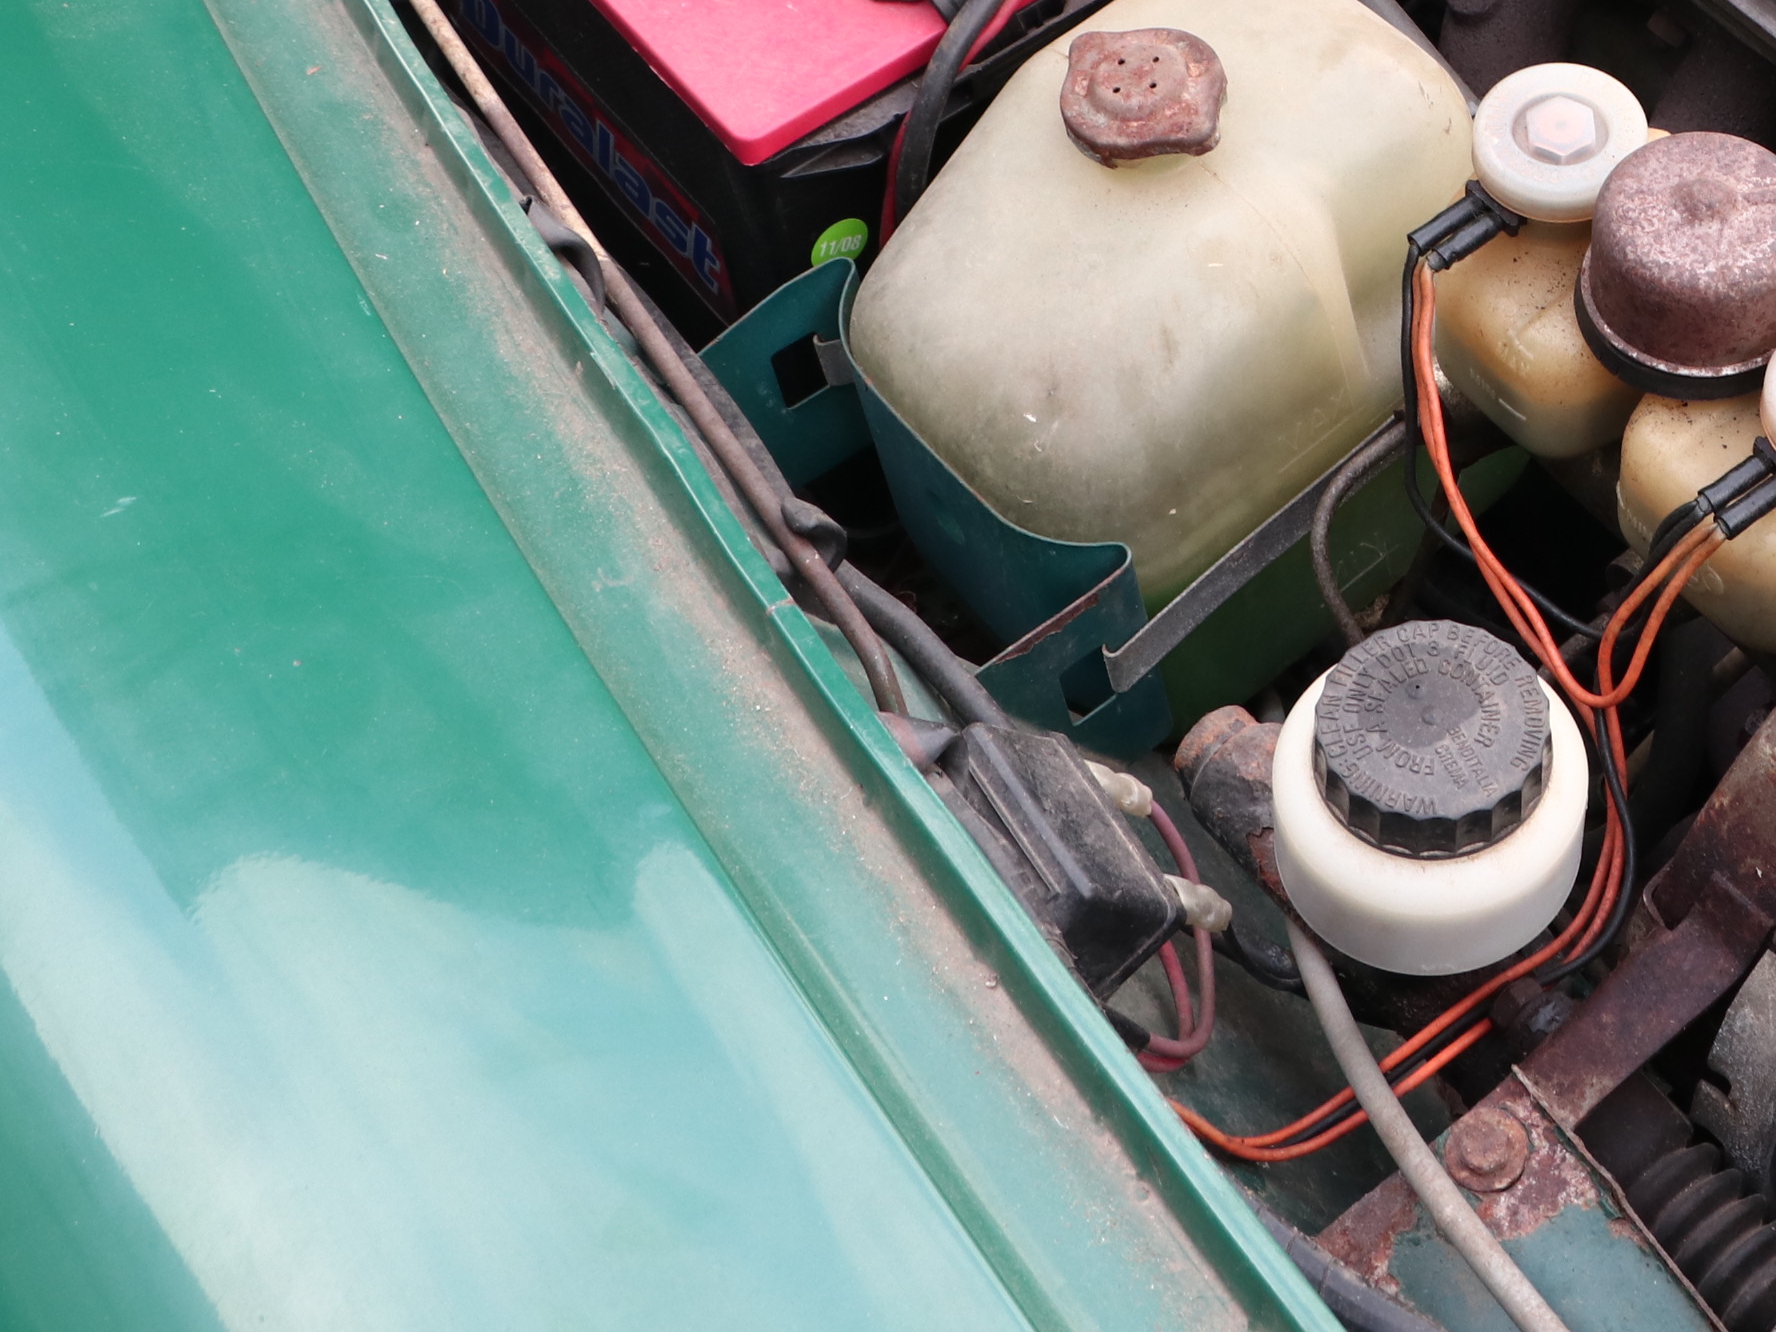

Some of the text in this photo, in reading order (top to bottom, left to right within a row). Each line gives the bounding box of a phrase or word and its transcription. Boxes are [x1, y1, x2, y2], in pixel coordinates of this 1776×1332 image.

[819, 234, 861, 257] 11/08
[1330, 635, 1391, 687] FILLER
[1397, 623, 1440, 643] CAP
[1447, 625, 1522, 672] BEFORE
[1319, 694, 1348, 759] CLEAN
[1342, 641, 1510, 761] USE ONLY DOT 3 FLUID
[1364, 658, 1500, 776] FROM A SEALED CONTAINER
[1510, 675, 1544, 771] REMOVING
